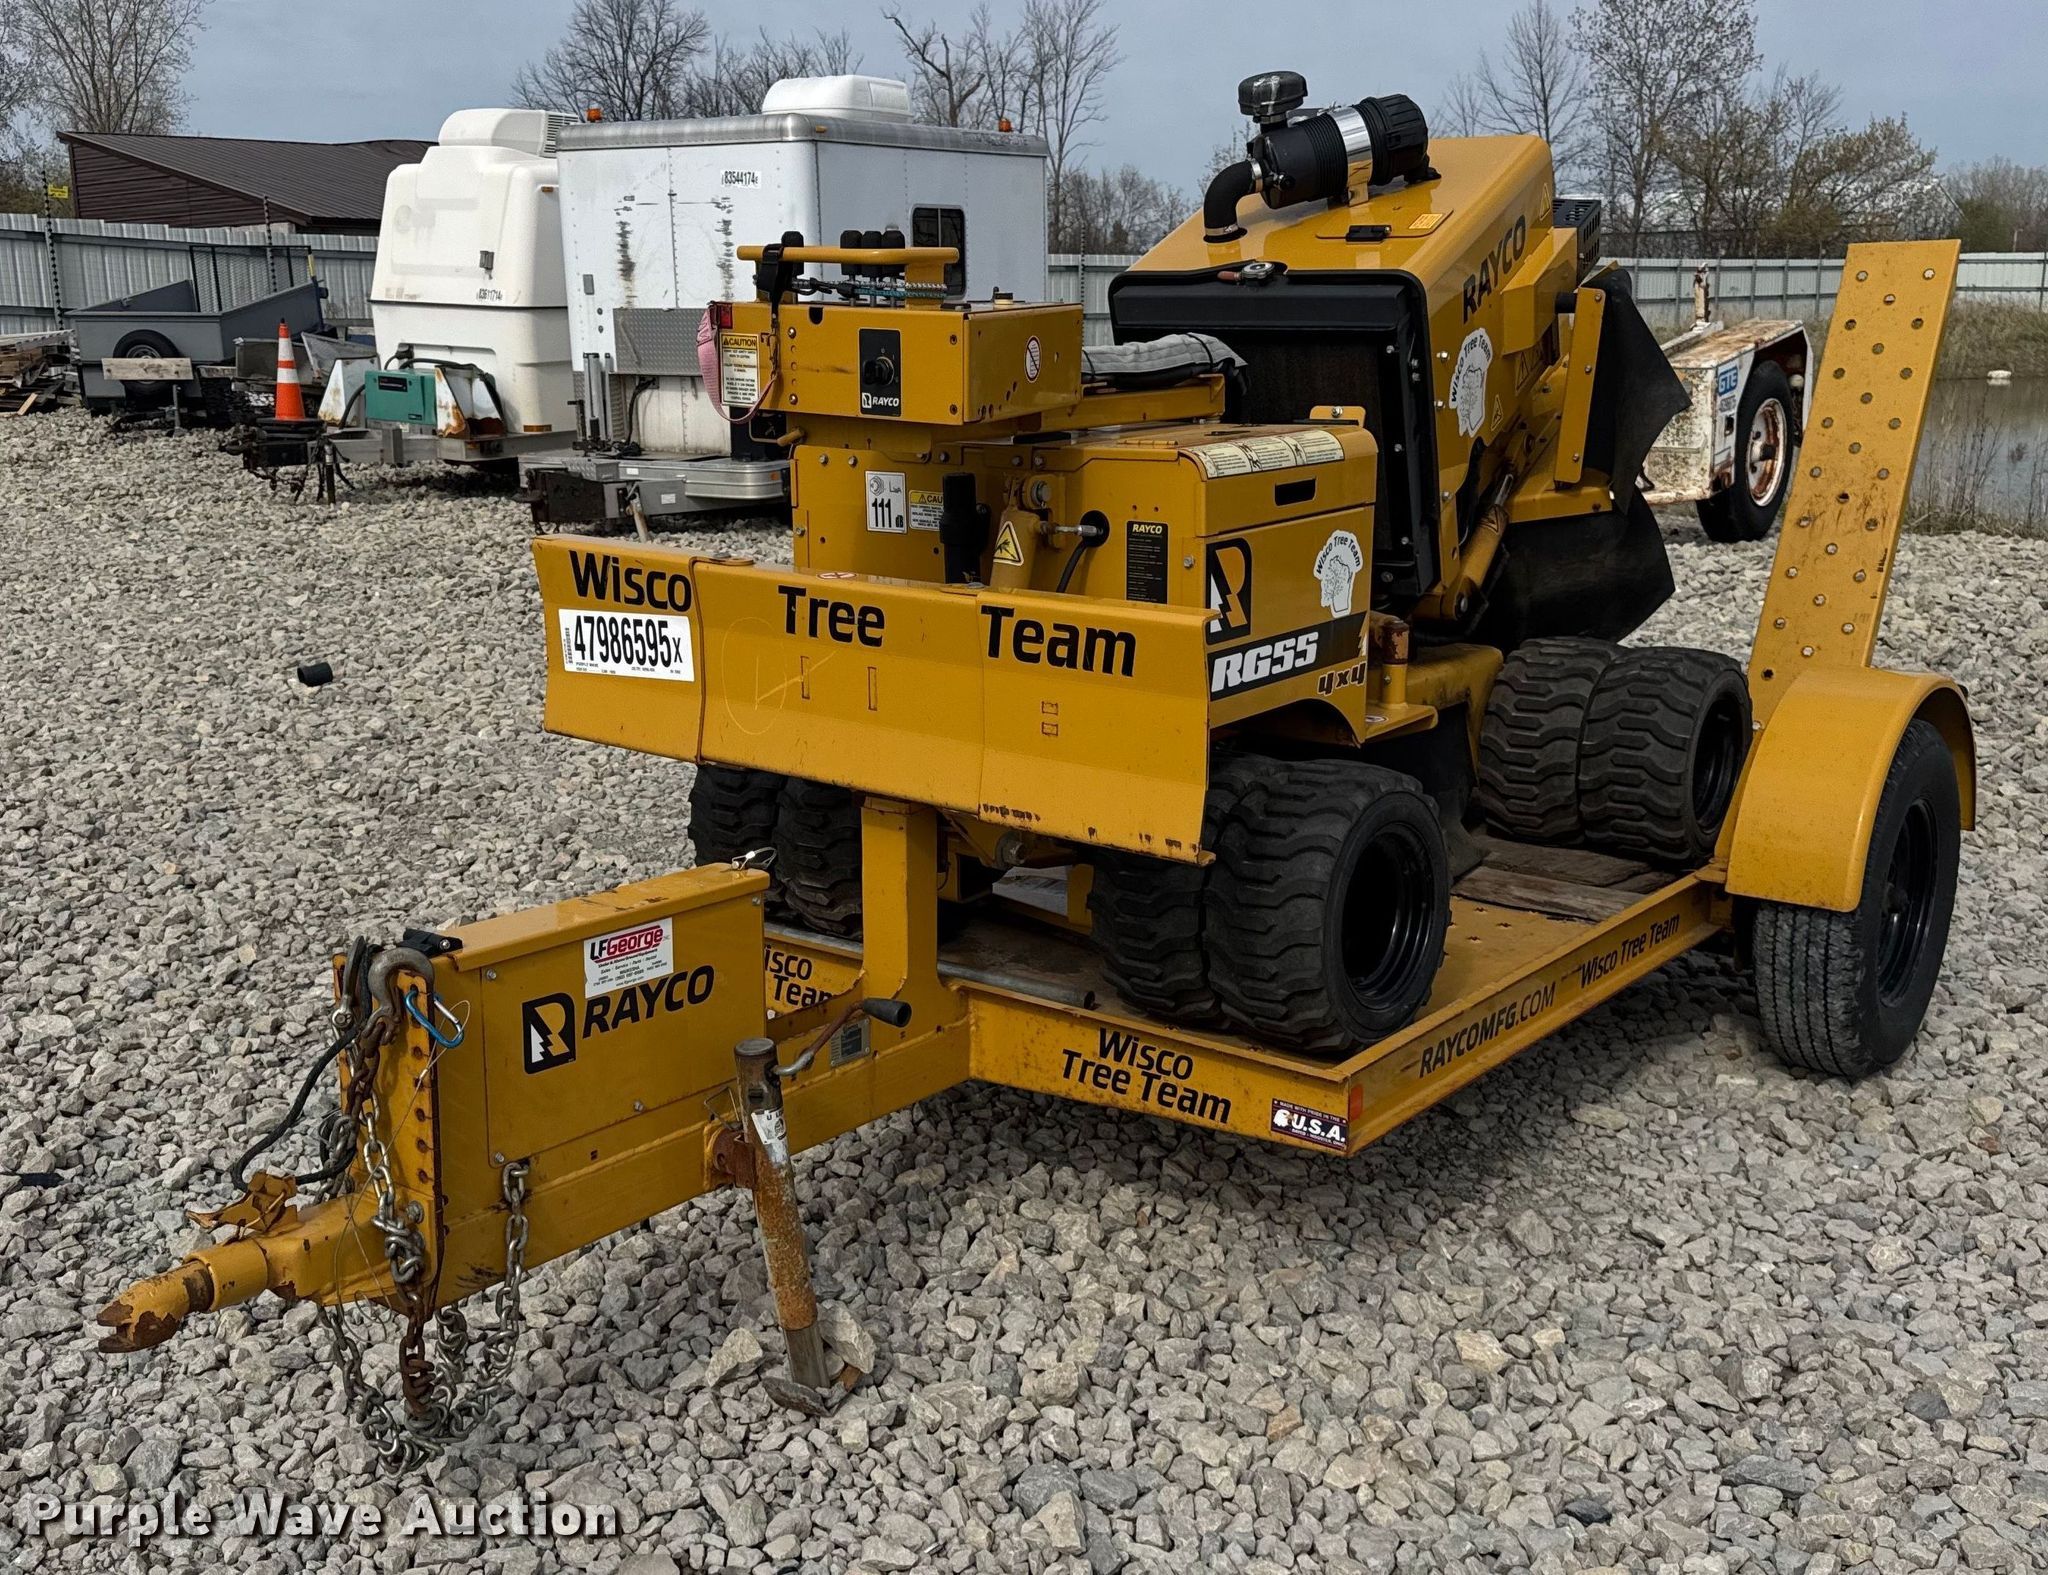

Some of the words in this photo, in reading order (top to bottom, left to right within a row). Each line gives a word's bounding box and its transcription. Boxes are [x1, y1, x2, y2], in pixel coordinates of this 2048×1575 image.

[1463, 214, 1526, 325] RAYCO
[729, 337, 756, 346] CAUTION
[1464, 337, 1478, 358] Tree
[1479, 335, 1491, 361] Team
[1718, 370, 1737, 392] GTE
[872, 396, 900, 407] RAYCO
[872, 498, 892, 528] 111
[1132, 524, 1163, 534] RAYCO
[1316, 542, 1333, 575] Wisco
[1333, 536, 1349, 547] Tree
[1348, 539, 1361, 567] Team
[568, 550, 692, 612] Wisco
[778, 585, 885, 647] Tree
[980, 604, 1137, 677] Team
[1211, 631, 1319, 692] RG55
[764, 944, 813, 980] isco
[1580, 949, 1618, 989] Wisco
[1620, 932, 1647, 965] Tree
[1649, 914, 1680, 948] Team
[582, 965, 715, 1039] RAYCO
[1418, 981, 1557, 1078] RAYCOMFG.COM
[1098, 1027, 1194, 1080] Wisco
[1062, 1048, 1131, 1095] Tree
[1140, 1070, 1232, 1124] Team
[1291, 1113, 1346, 1142] U.S.A.
